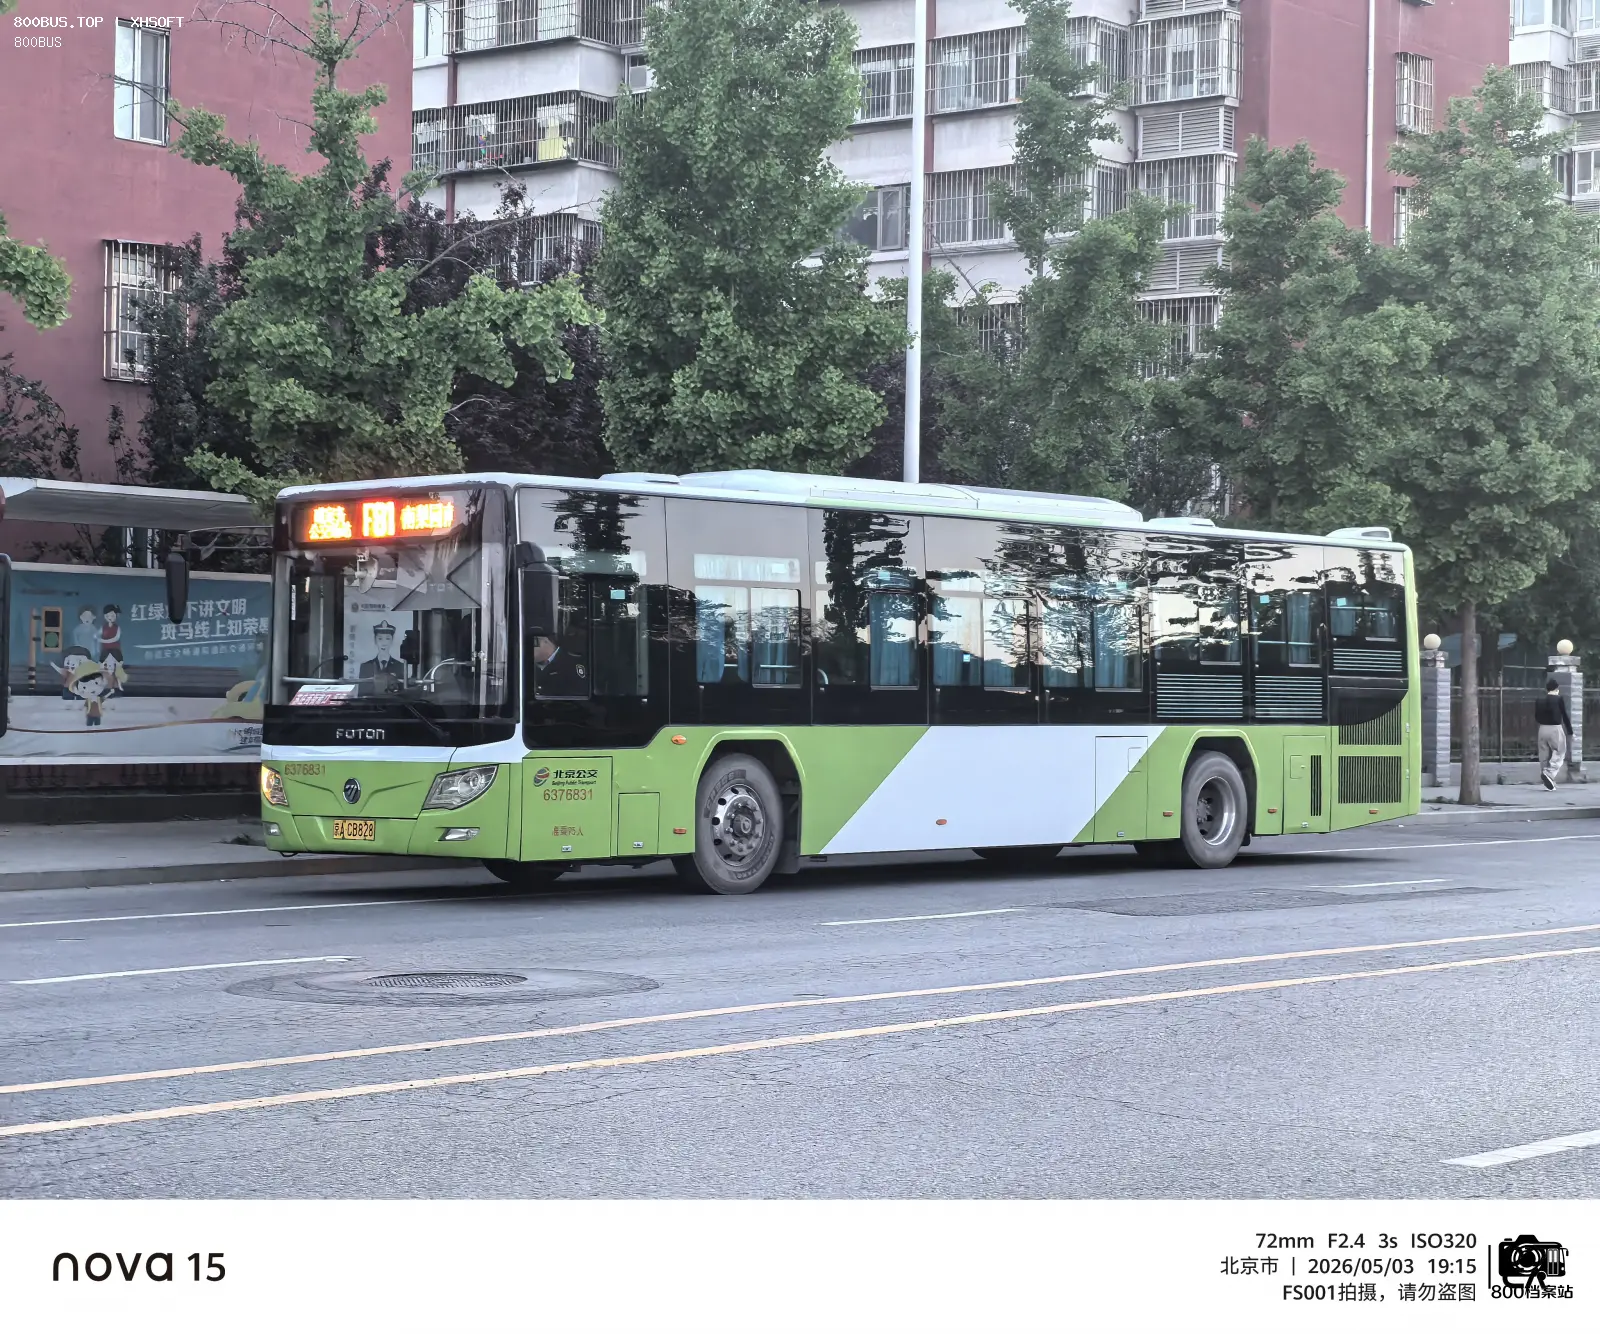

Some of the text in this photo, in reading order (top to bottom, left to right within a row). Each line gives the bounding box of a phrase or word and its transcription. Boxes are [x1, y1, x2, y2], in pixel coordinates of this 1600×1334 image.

[131, 598, 247, 621] 红绿下讲文明
[336, 728, 385, 740] FOTON
[284, 763, 326, 777] 6376831
[553, 769, 598, 779] 北京公交
[543, 788, 593, 801] 6376831
